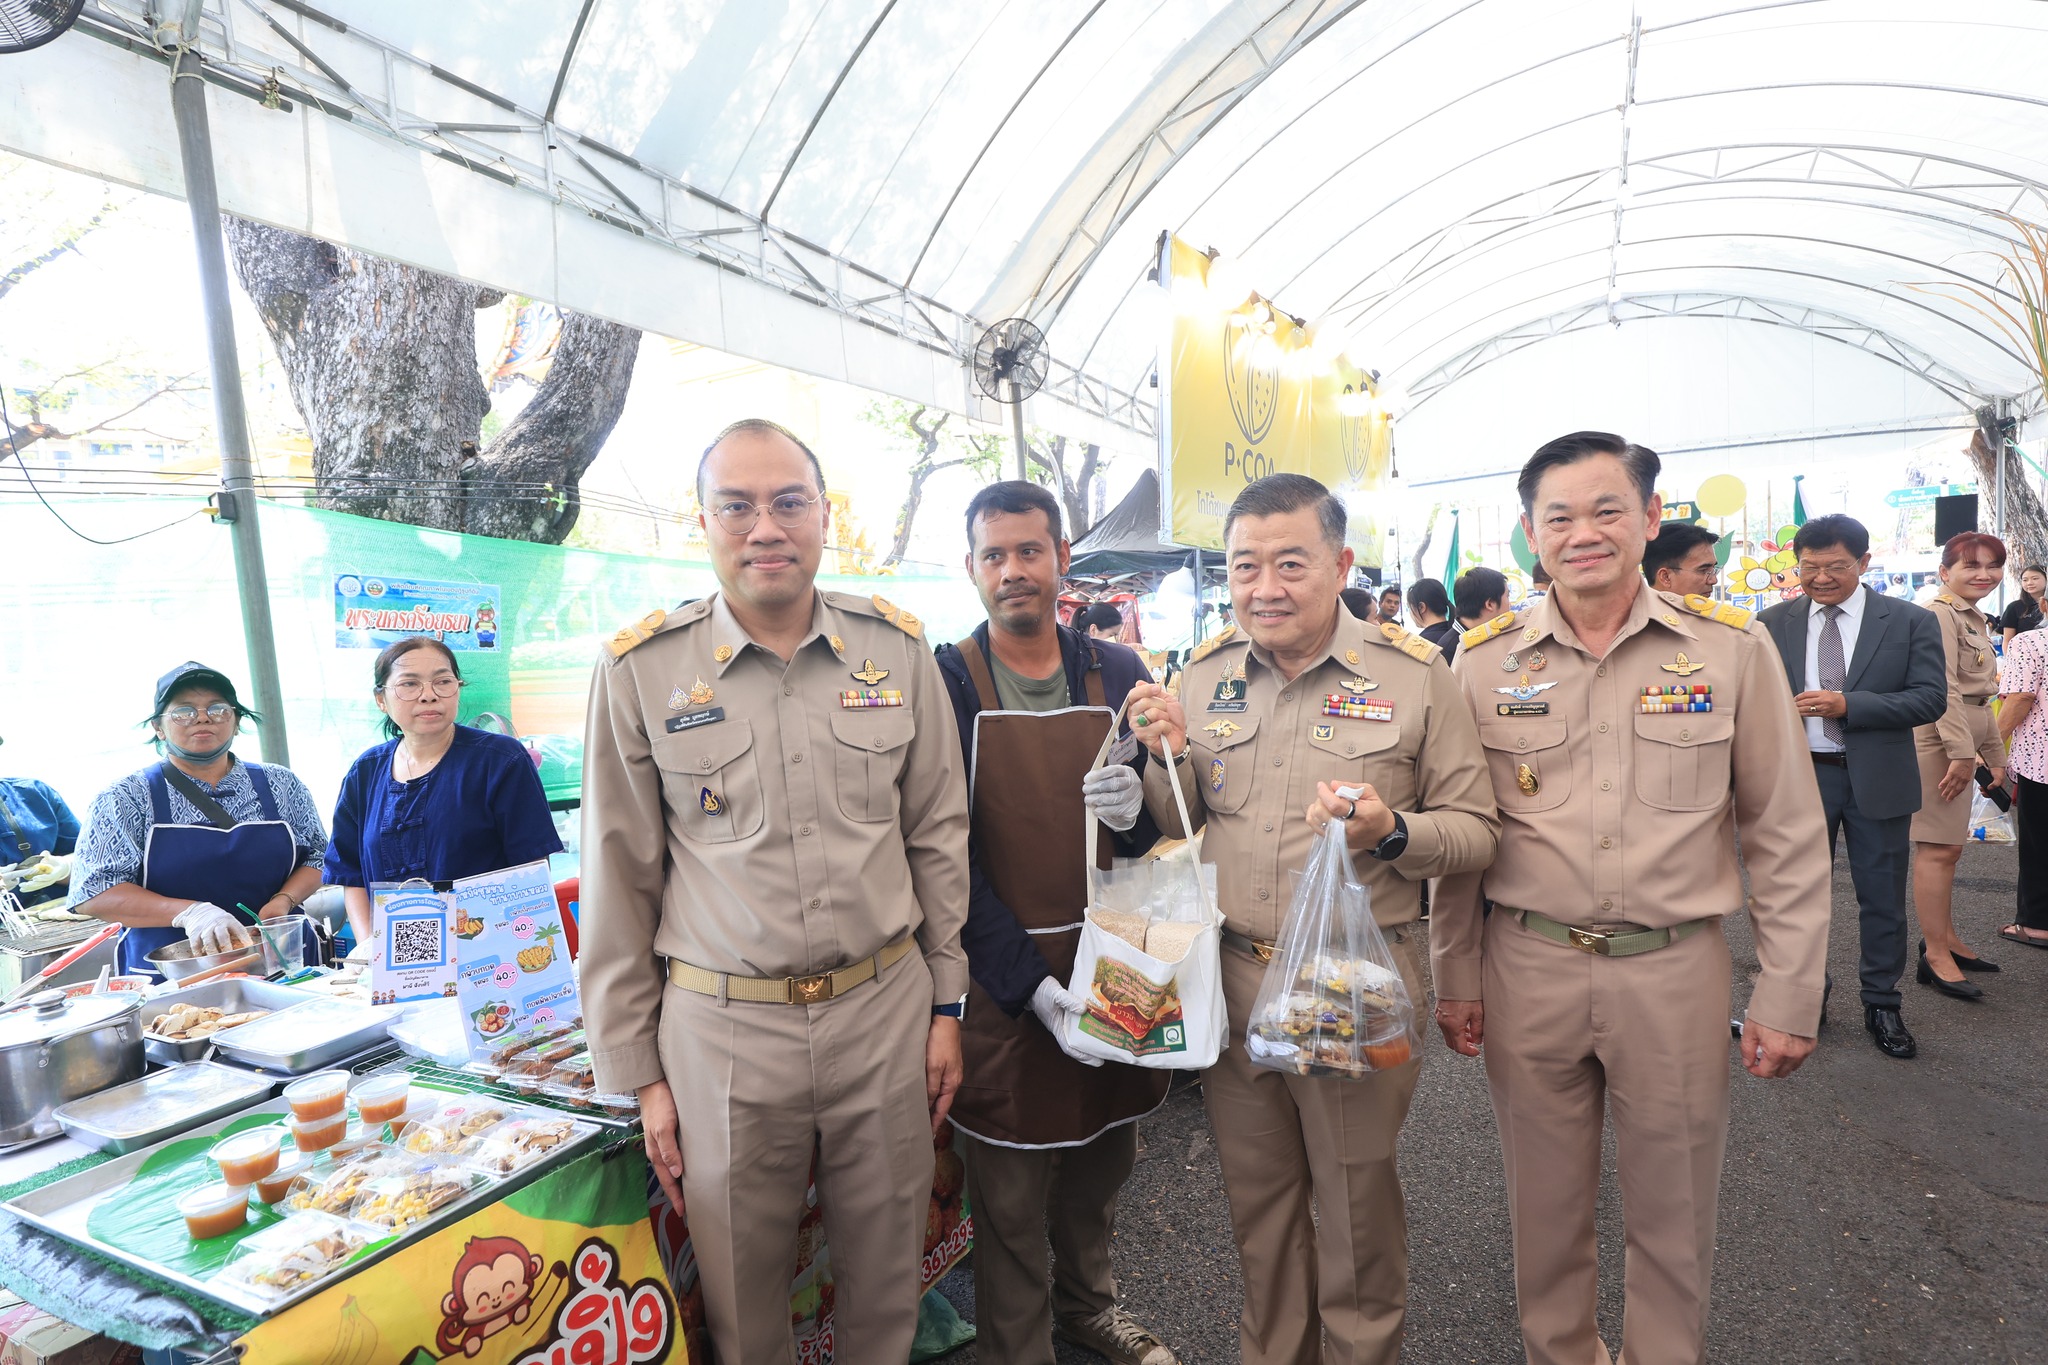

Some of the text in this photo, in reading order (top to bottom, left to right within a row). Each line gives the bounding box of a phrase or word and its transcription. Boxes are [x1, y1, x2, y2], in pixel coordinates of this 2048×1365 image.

[345, 604, 471, 641] พระนครศรีอยุธยา
[456, 884, 505, 902] าหกิจชุมชน
[460, 964, 495, 979] กล้วยทอด
